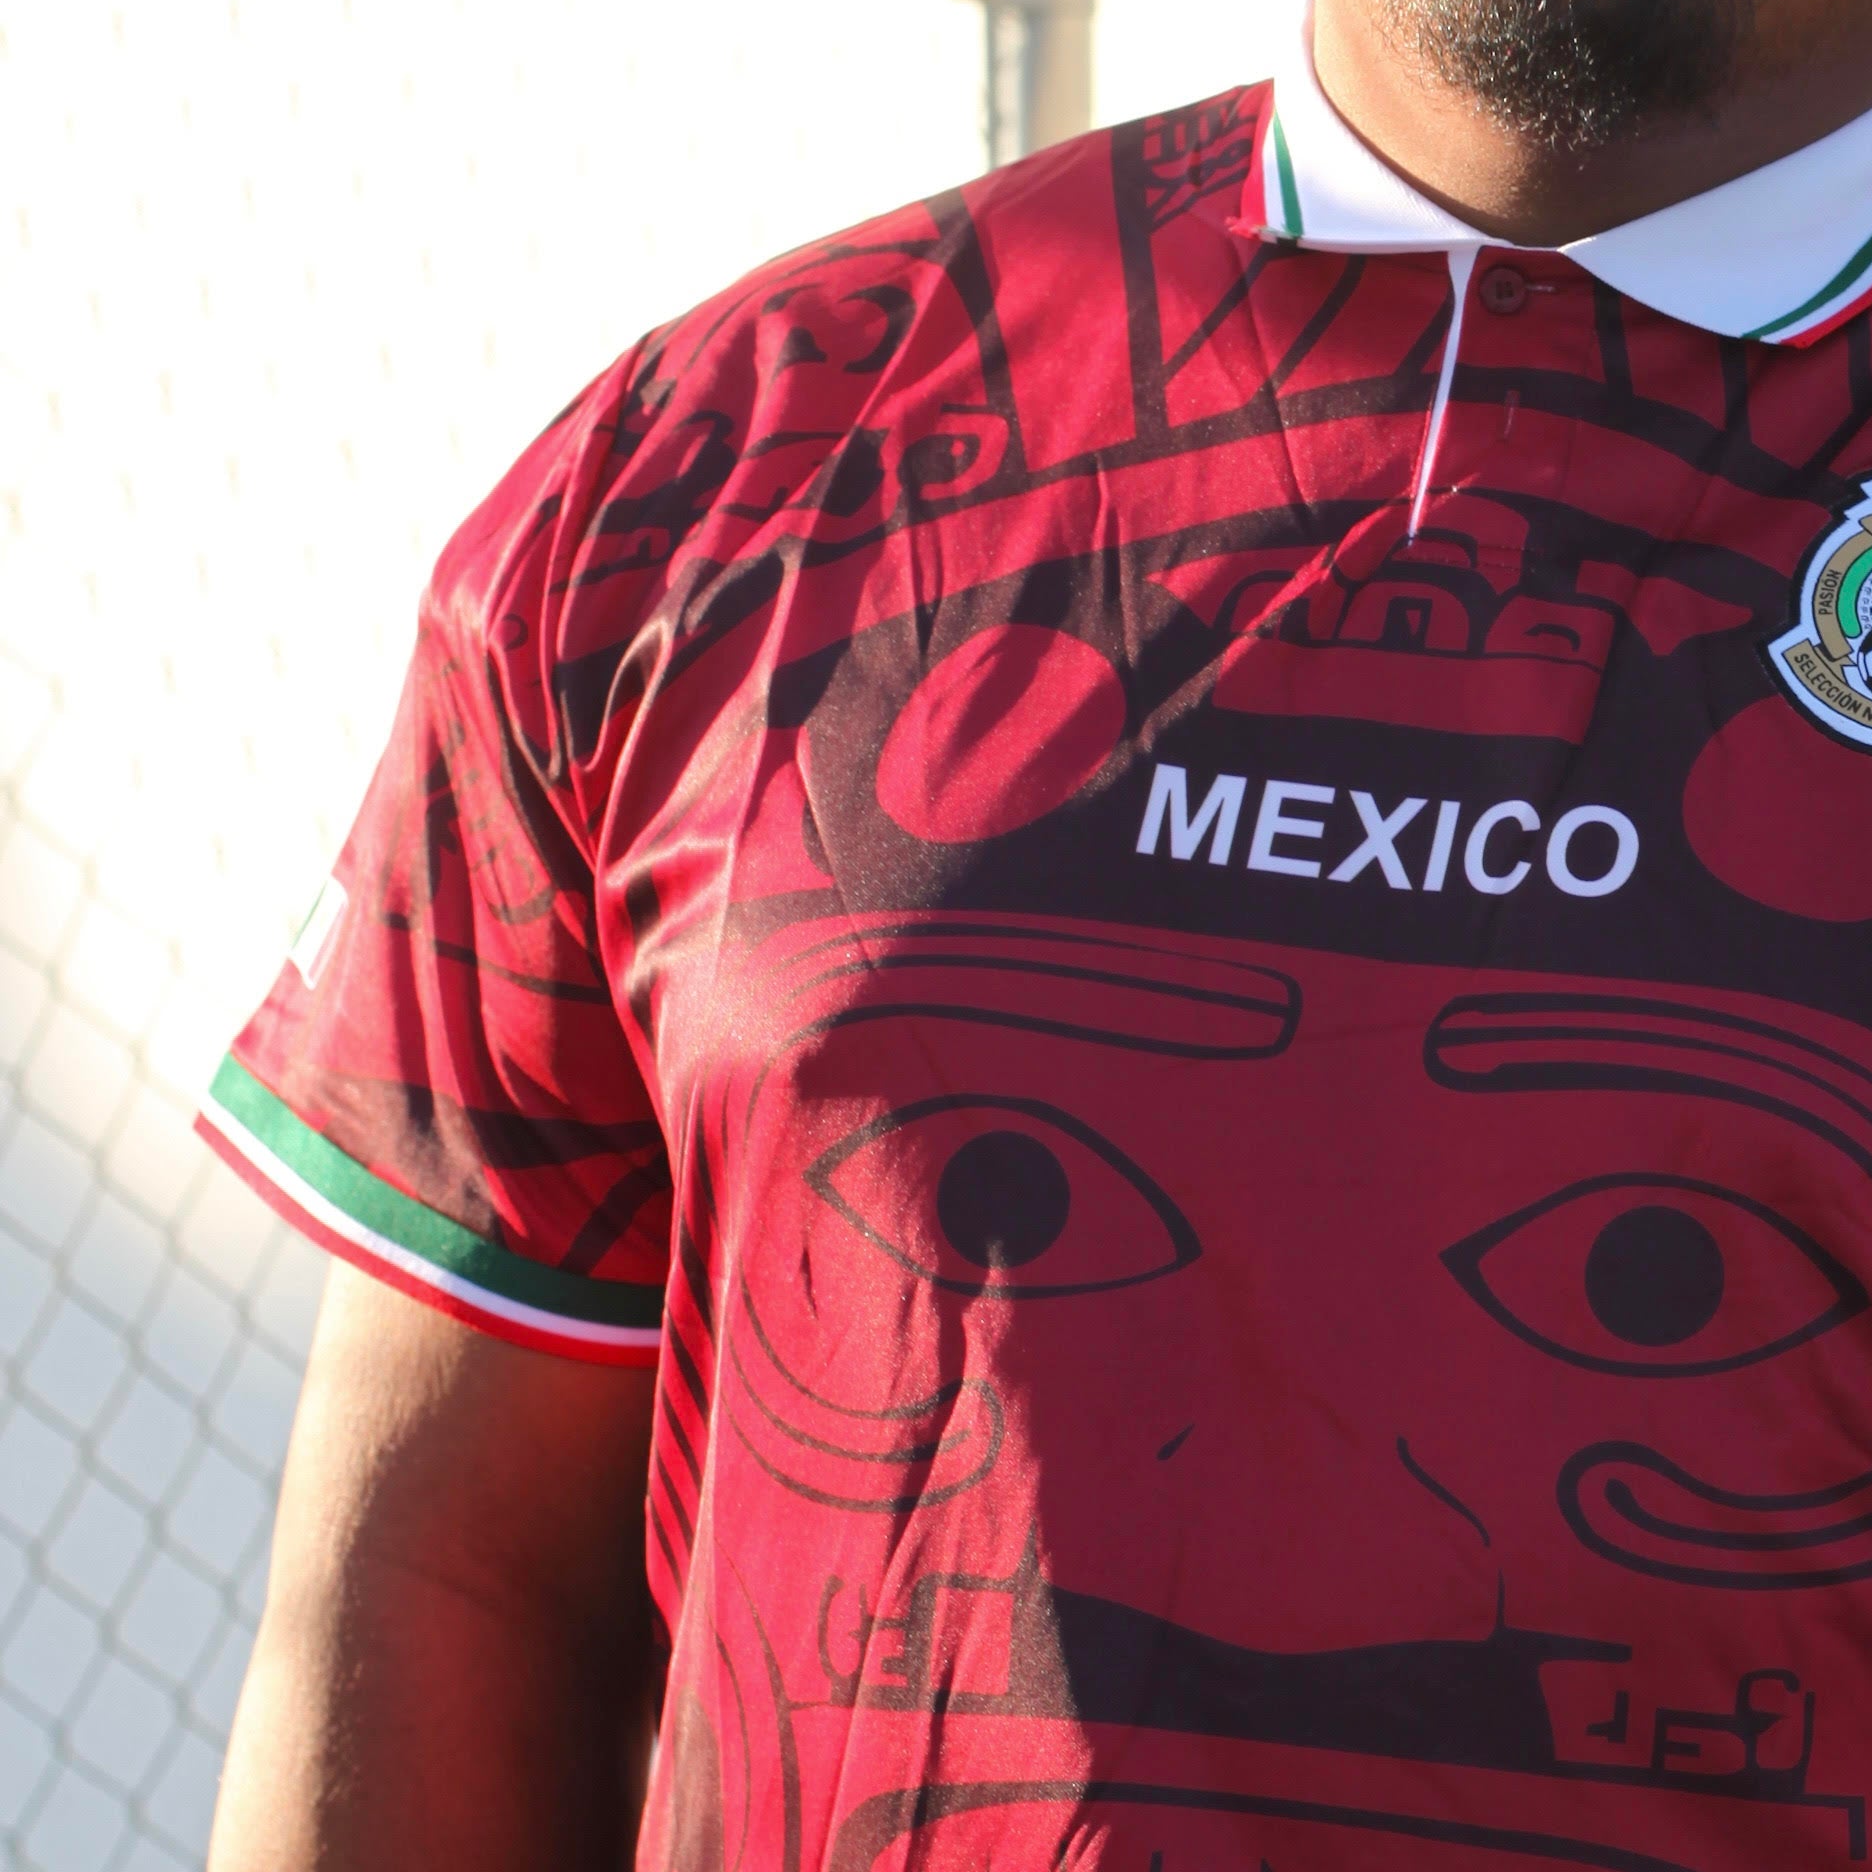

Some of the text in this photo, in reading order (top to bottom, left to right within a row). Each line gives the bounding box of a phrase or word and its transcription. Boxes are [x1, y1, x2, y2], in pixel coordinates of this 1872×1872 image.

[1818, 569, 1841, 616] PASIÓN
[1793, 652, 1862, 714] SELECCIÓN
[1136, 763, 1639, 898] MEXICO
